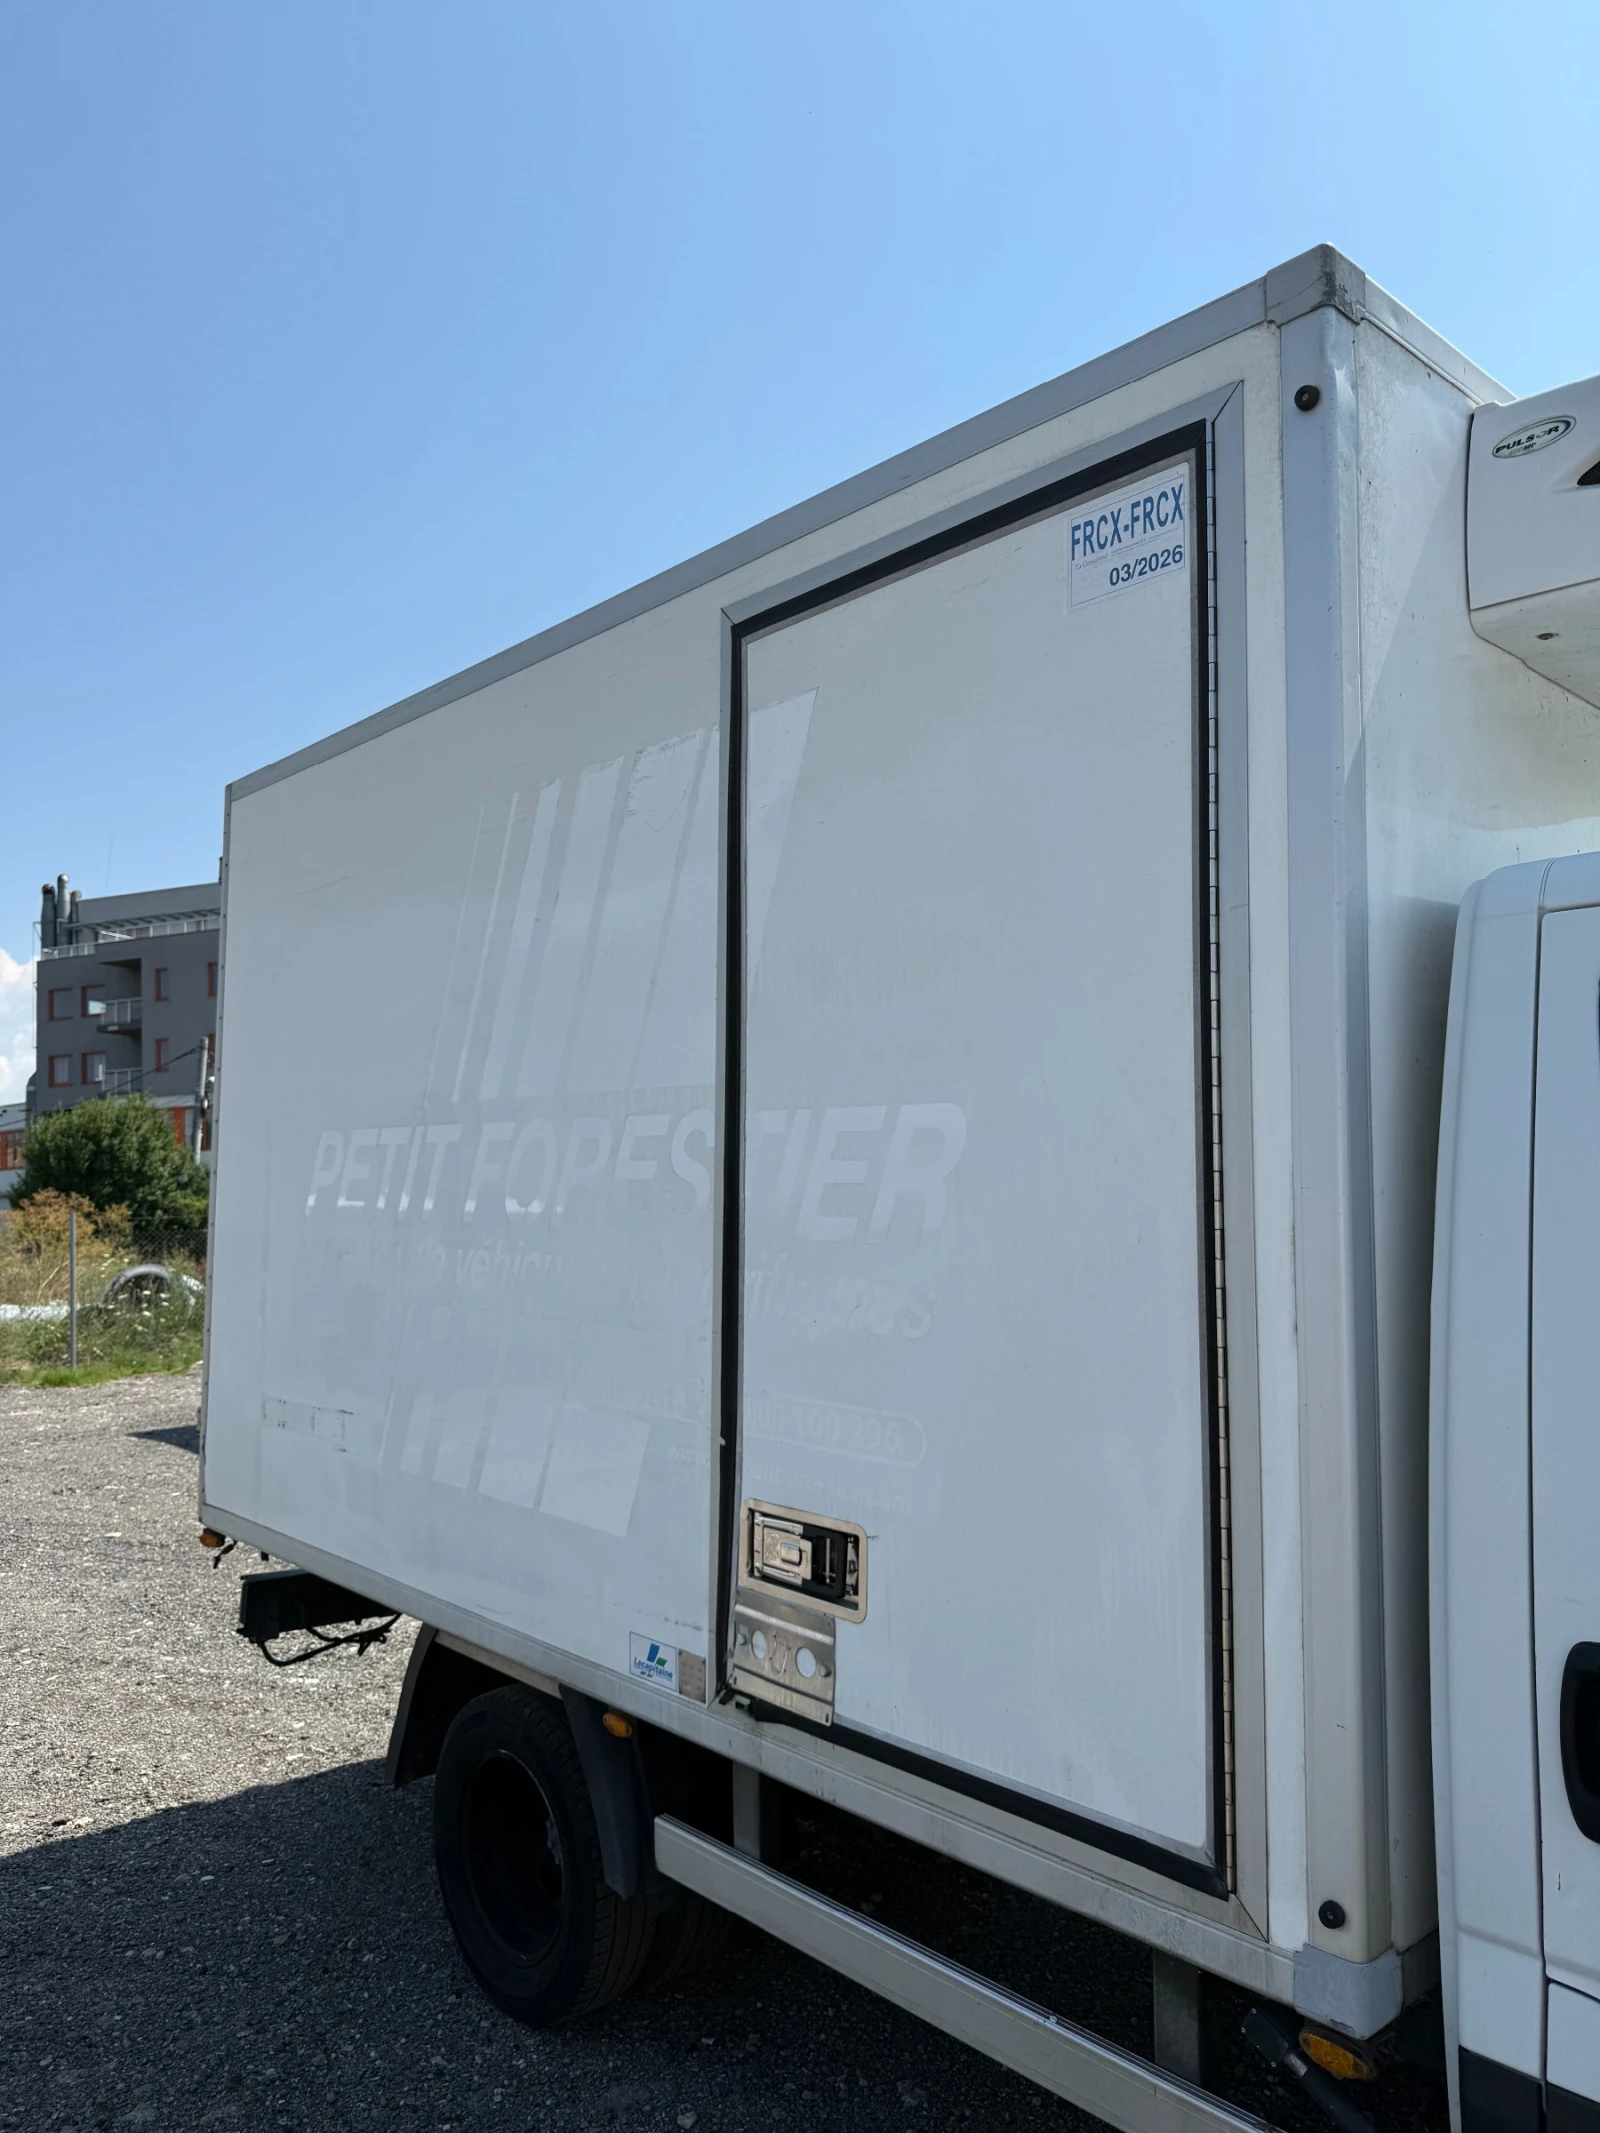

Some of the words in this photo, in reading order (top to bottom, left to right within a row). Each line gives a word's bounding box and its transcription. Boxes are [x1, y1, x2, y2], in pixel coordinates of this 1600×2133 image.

[1495, 425, 1560, 454] PULSOR
[1071, 483, 1183, 561] FRCX-FRCX
[1109, 544, 1183, 586] 03/2026
[305, 1123, 463, 1220] PETIT
[463, 1101, 967, 1244] FORESTIER
